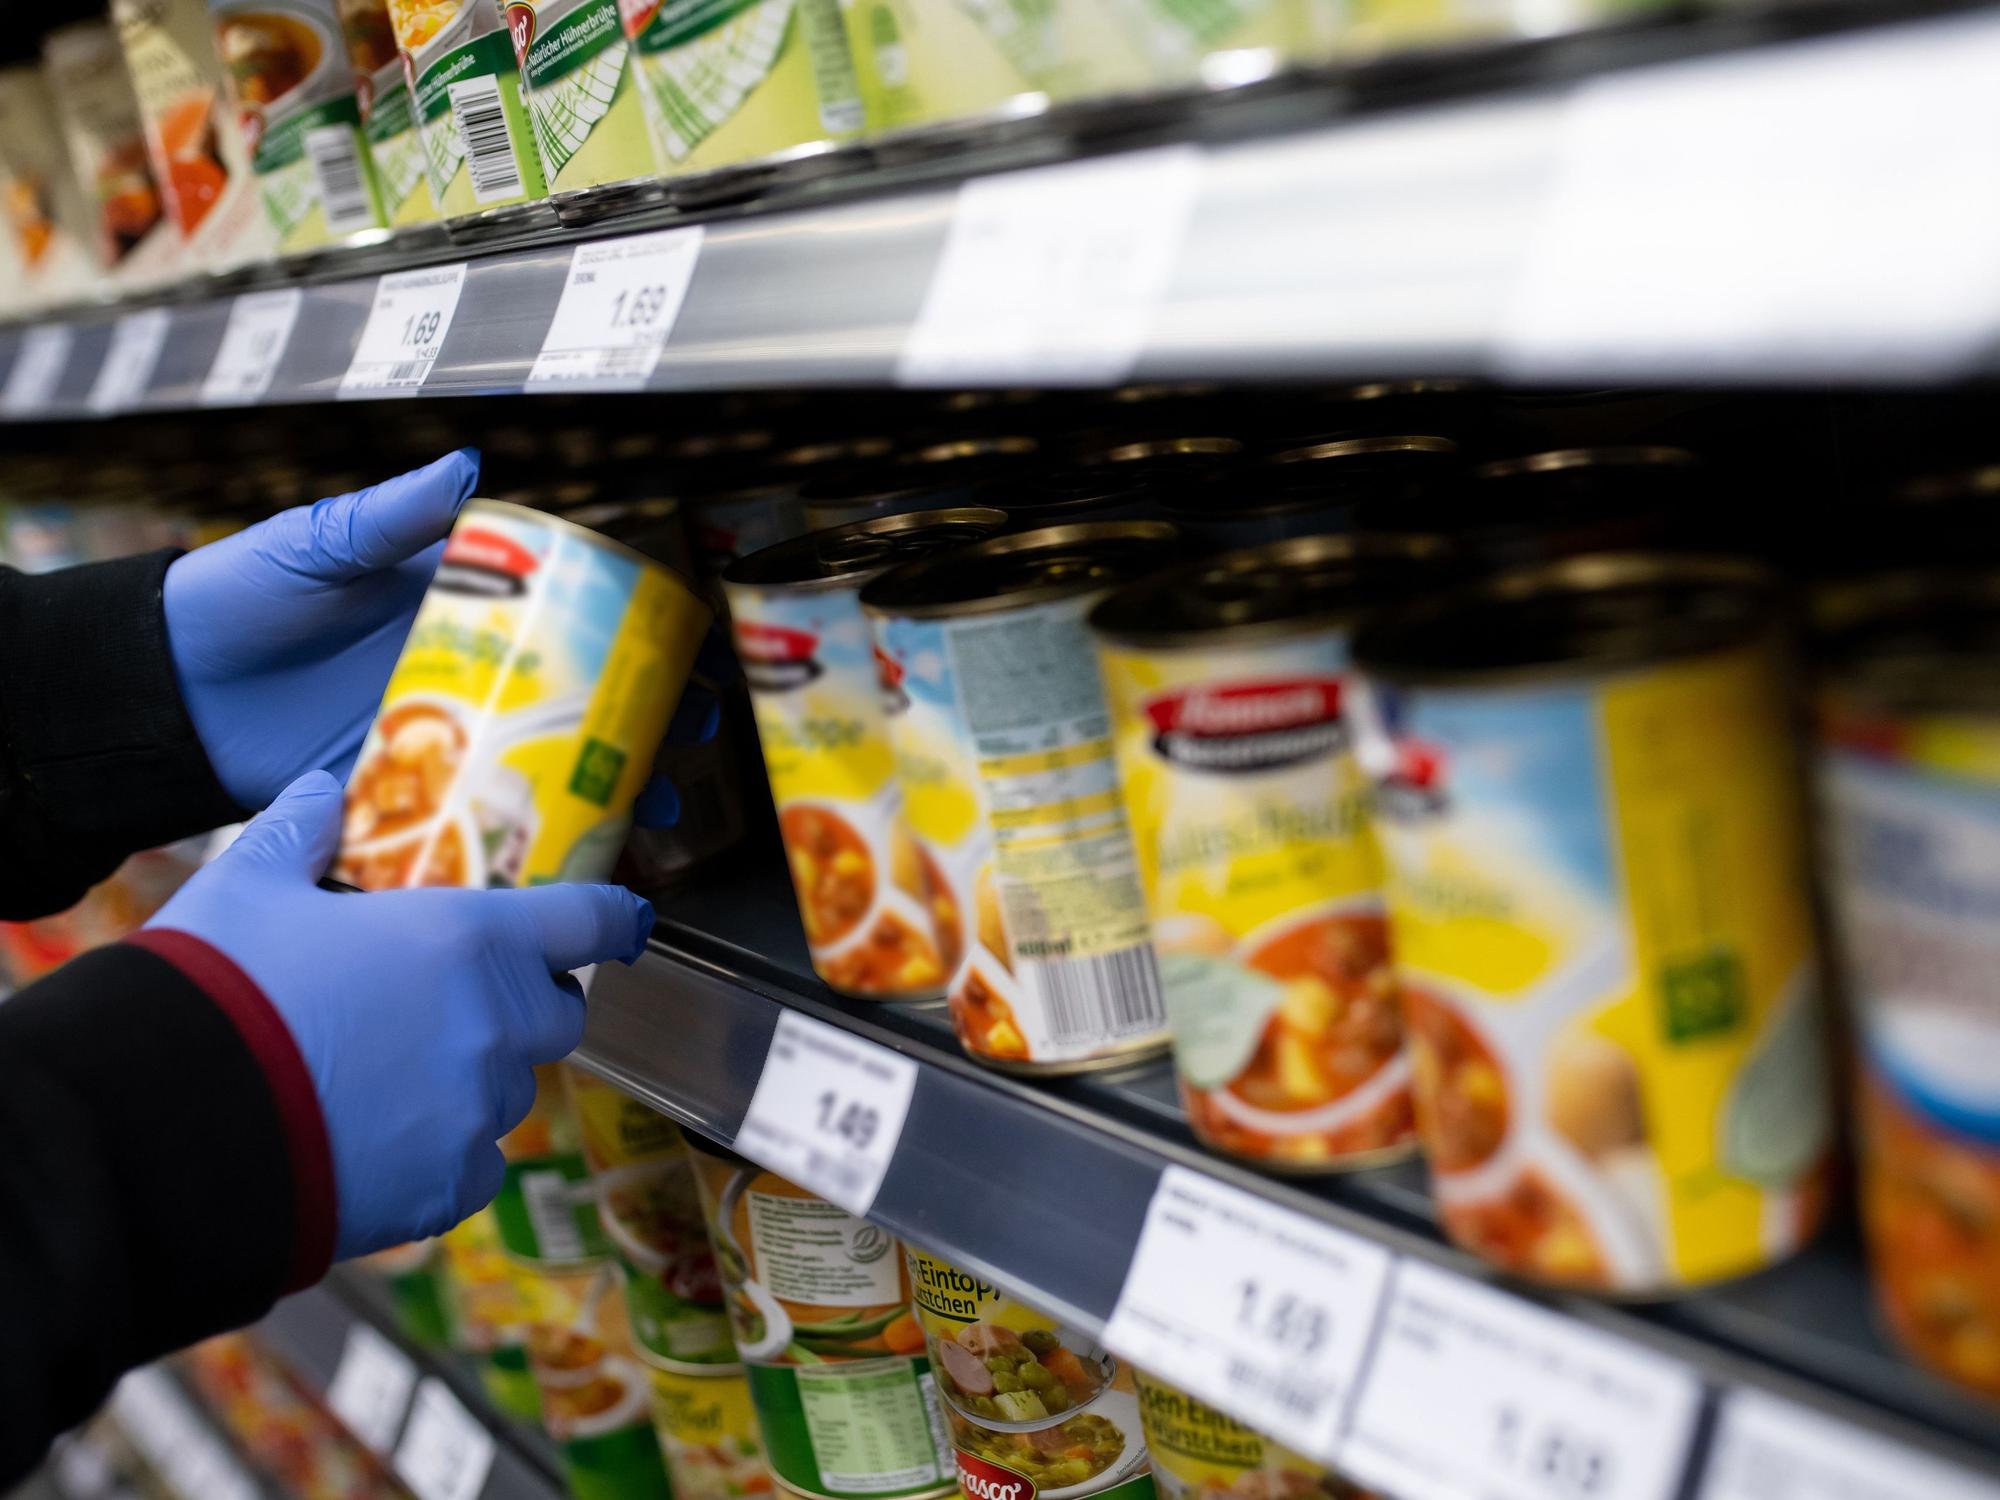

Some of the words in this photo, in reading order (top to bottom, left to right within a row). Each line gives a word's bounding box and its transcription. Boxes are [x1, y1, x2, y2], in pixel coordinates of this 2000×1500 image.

[528, 38, 561, 67] Natürlicher
[559, 4, 617, 46] Hühnerbrühe
[401, 310, 441, 346] 1.69
[610, 285, 667, 328] 1.69
